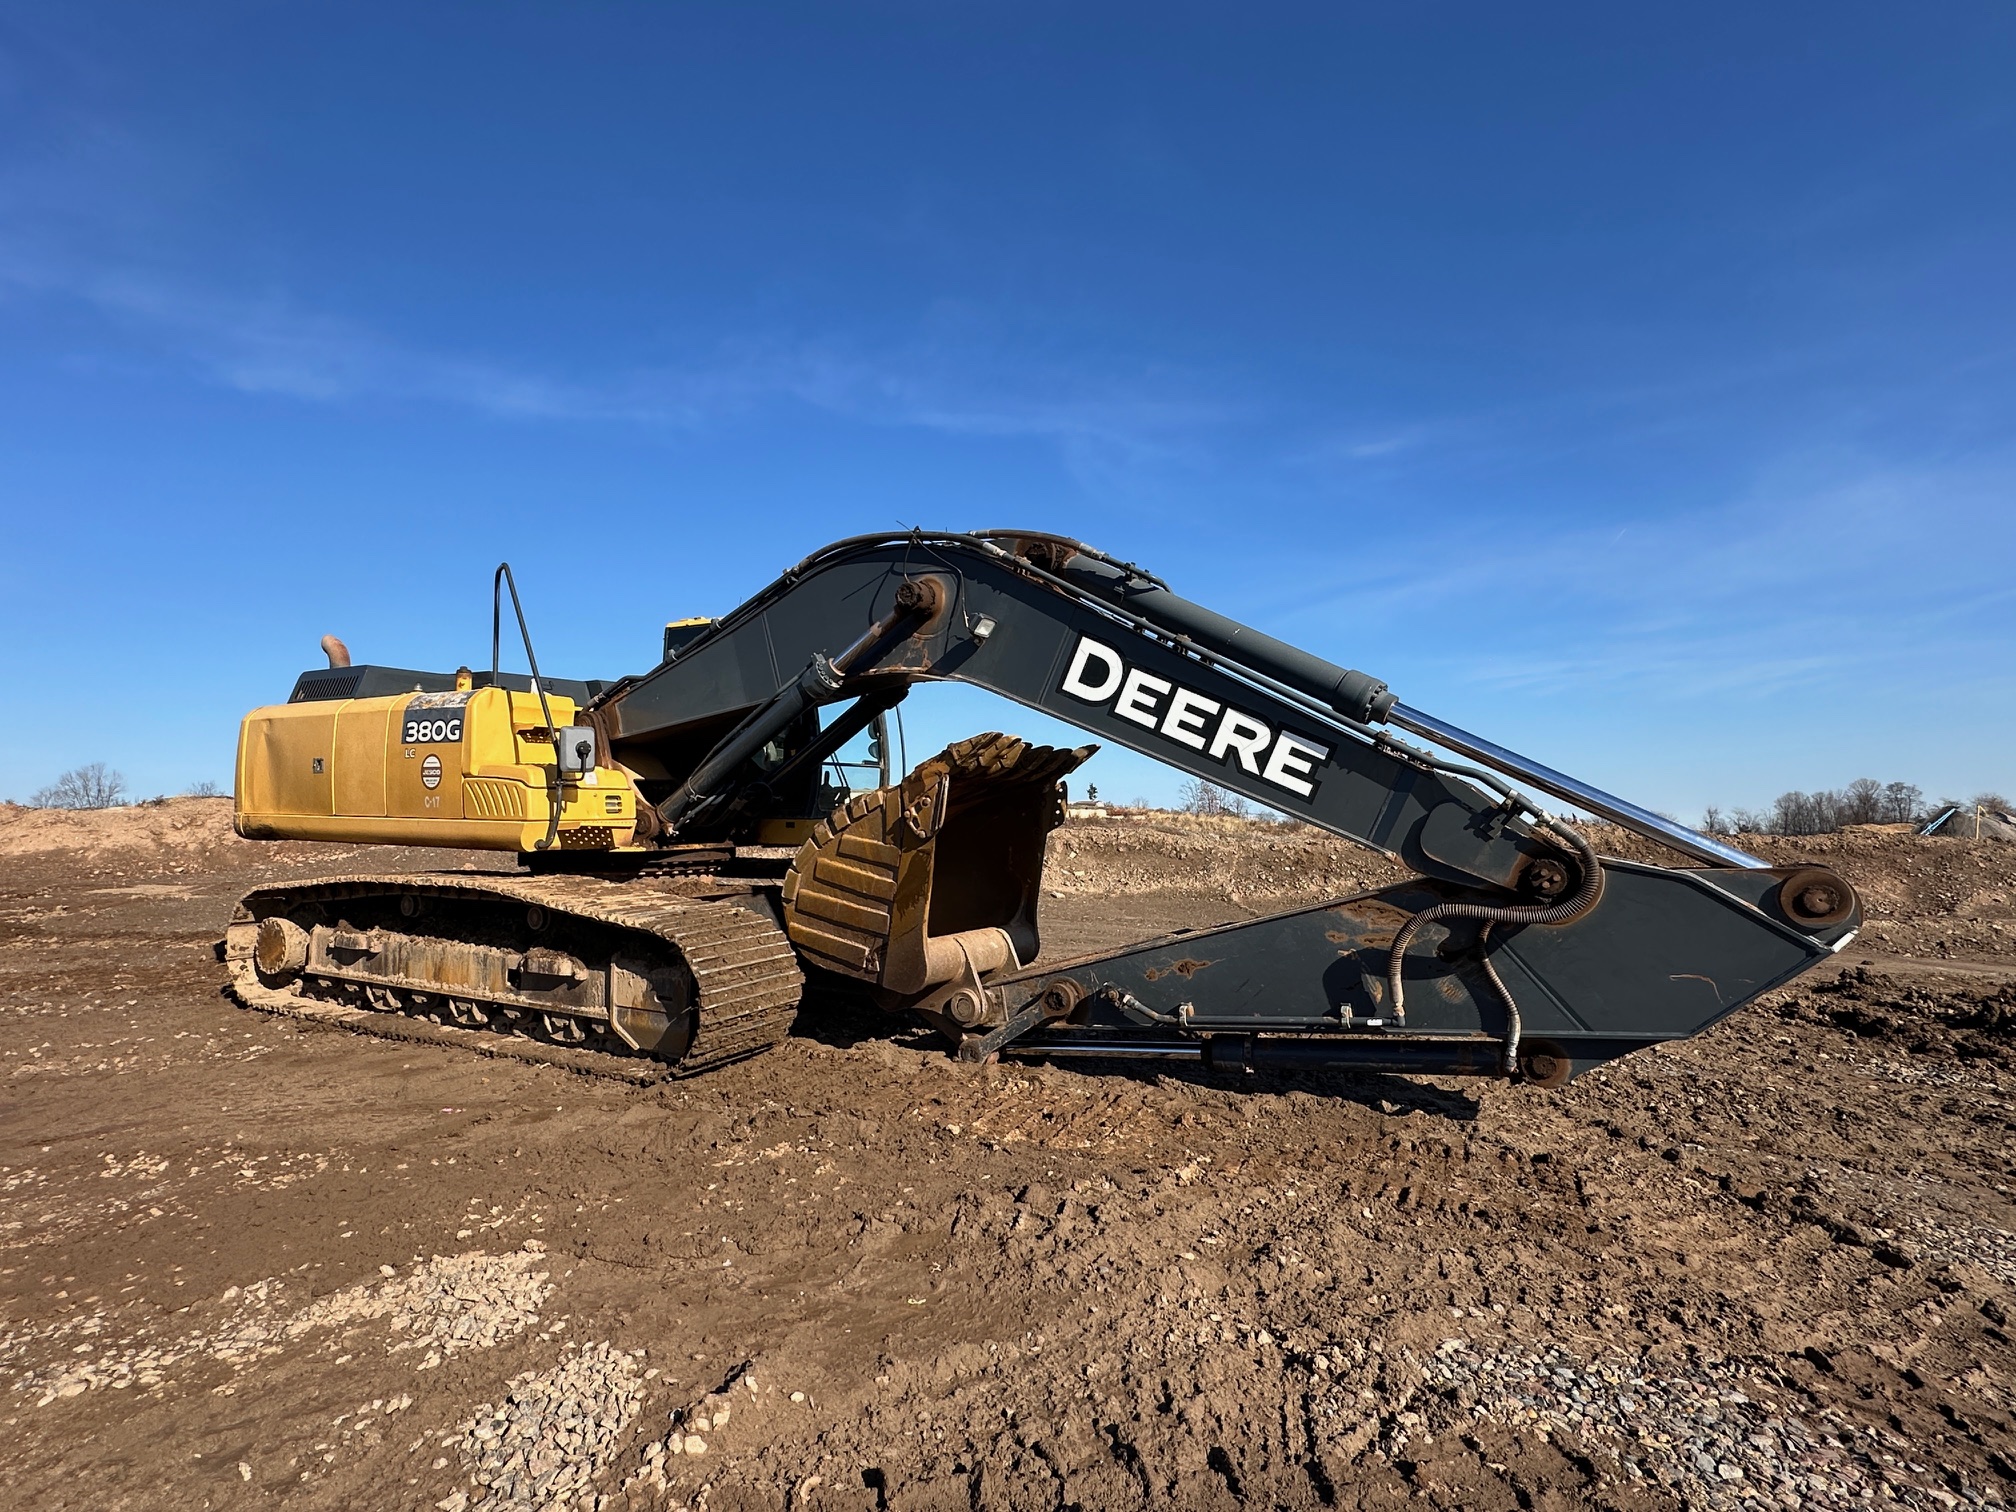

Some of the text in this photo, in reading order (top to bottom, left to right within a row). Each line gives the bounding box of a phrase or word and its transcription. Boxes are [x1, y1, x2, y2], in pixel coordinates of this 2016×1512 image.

[1061, 636, 1330, 798] DEERE
[405, 719, 461, 743] 380G
[404, 748, 416, 758] LC
[424, 796, 440, 808] C-17
